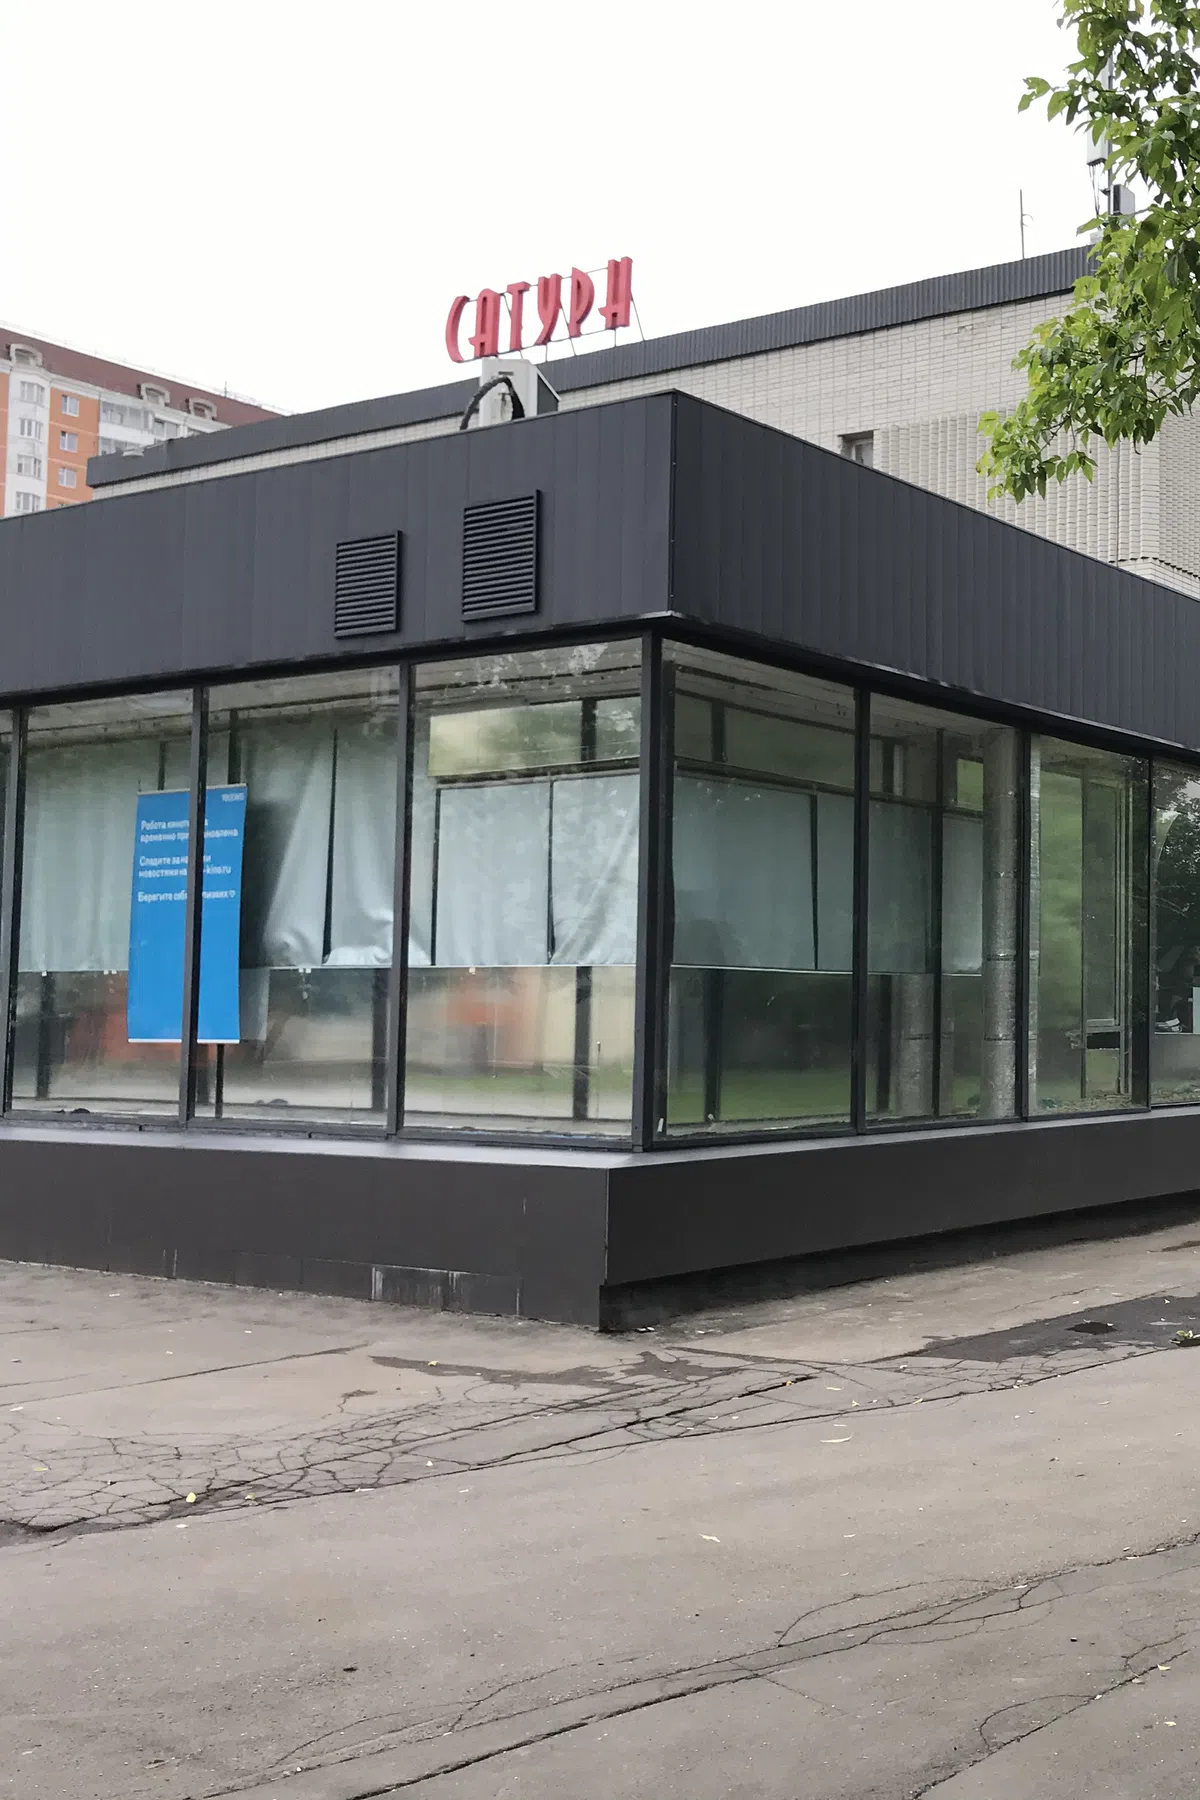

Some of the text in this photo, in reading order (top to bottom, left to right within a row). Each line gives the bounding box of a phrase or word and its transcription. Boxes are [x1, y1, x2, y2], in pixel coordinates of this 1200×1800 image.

[445, 256, 633, 363] САТУРН
[141, 820, 166, 830] Работа
[139, 856, 171, 867] Следите
[138, 868, 178, 878] новостями
[137, 891, 172, 903] Берегите
